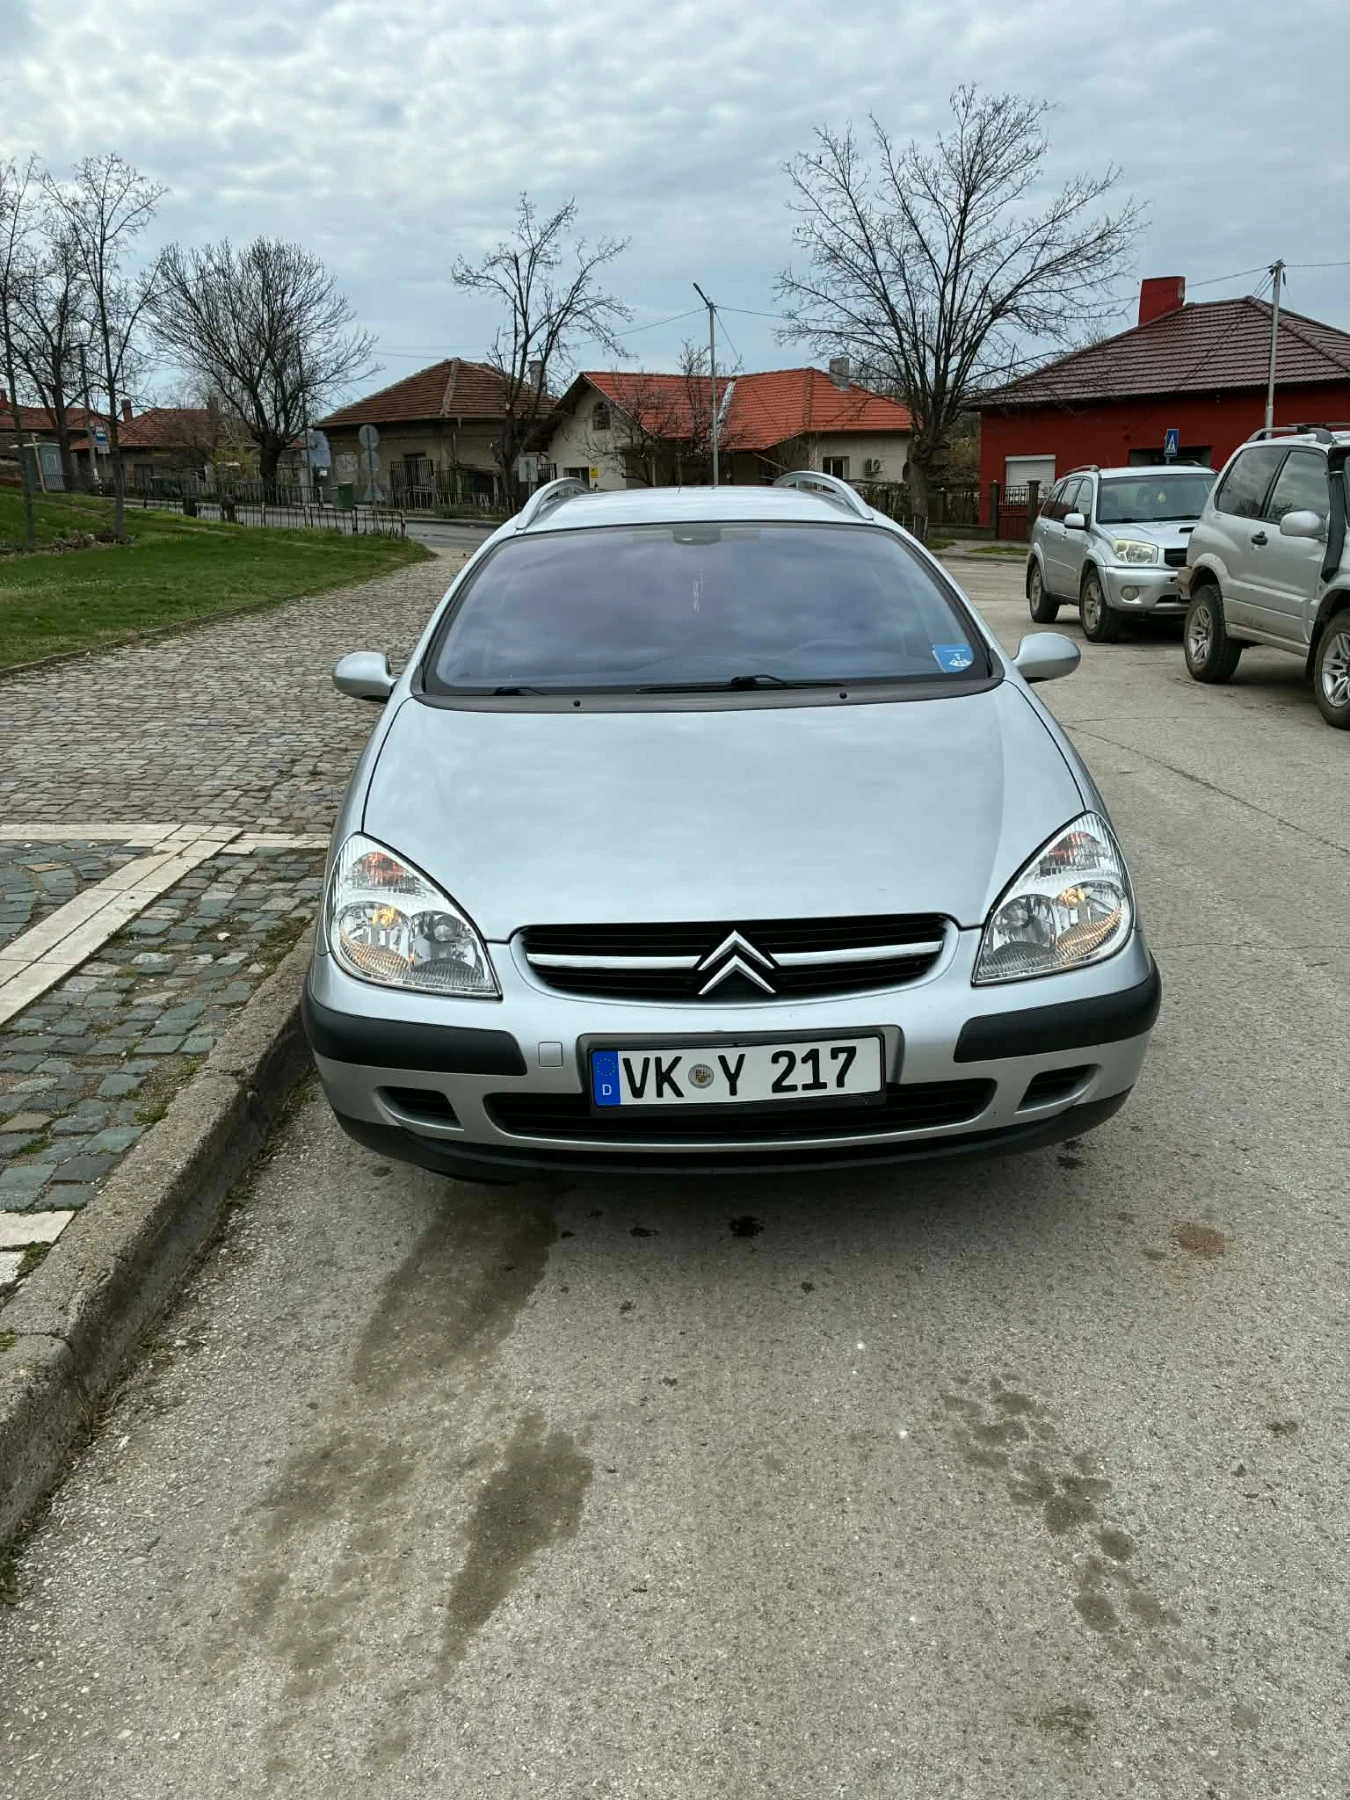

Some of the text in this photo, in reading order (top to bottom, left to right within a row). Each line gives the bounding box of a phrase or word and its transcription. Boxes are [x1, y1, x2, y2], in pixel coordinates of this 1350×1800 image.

[622, 1045, 857, 1099] VK Y 217
[602, 1084, 612, 1096] D
